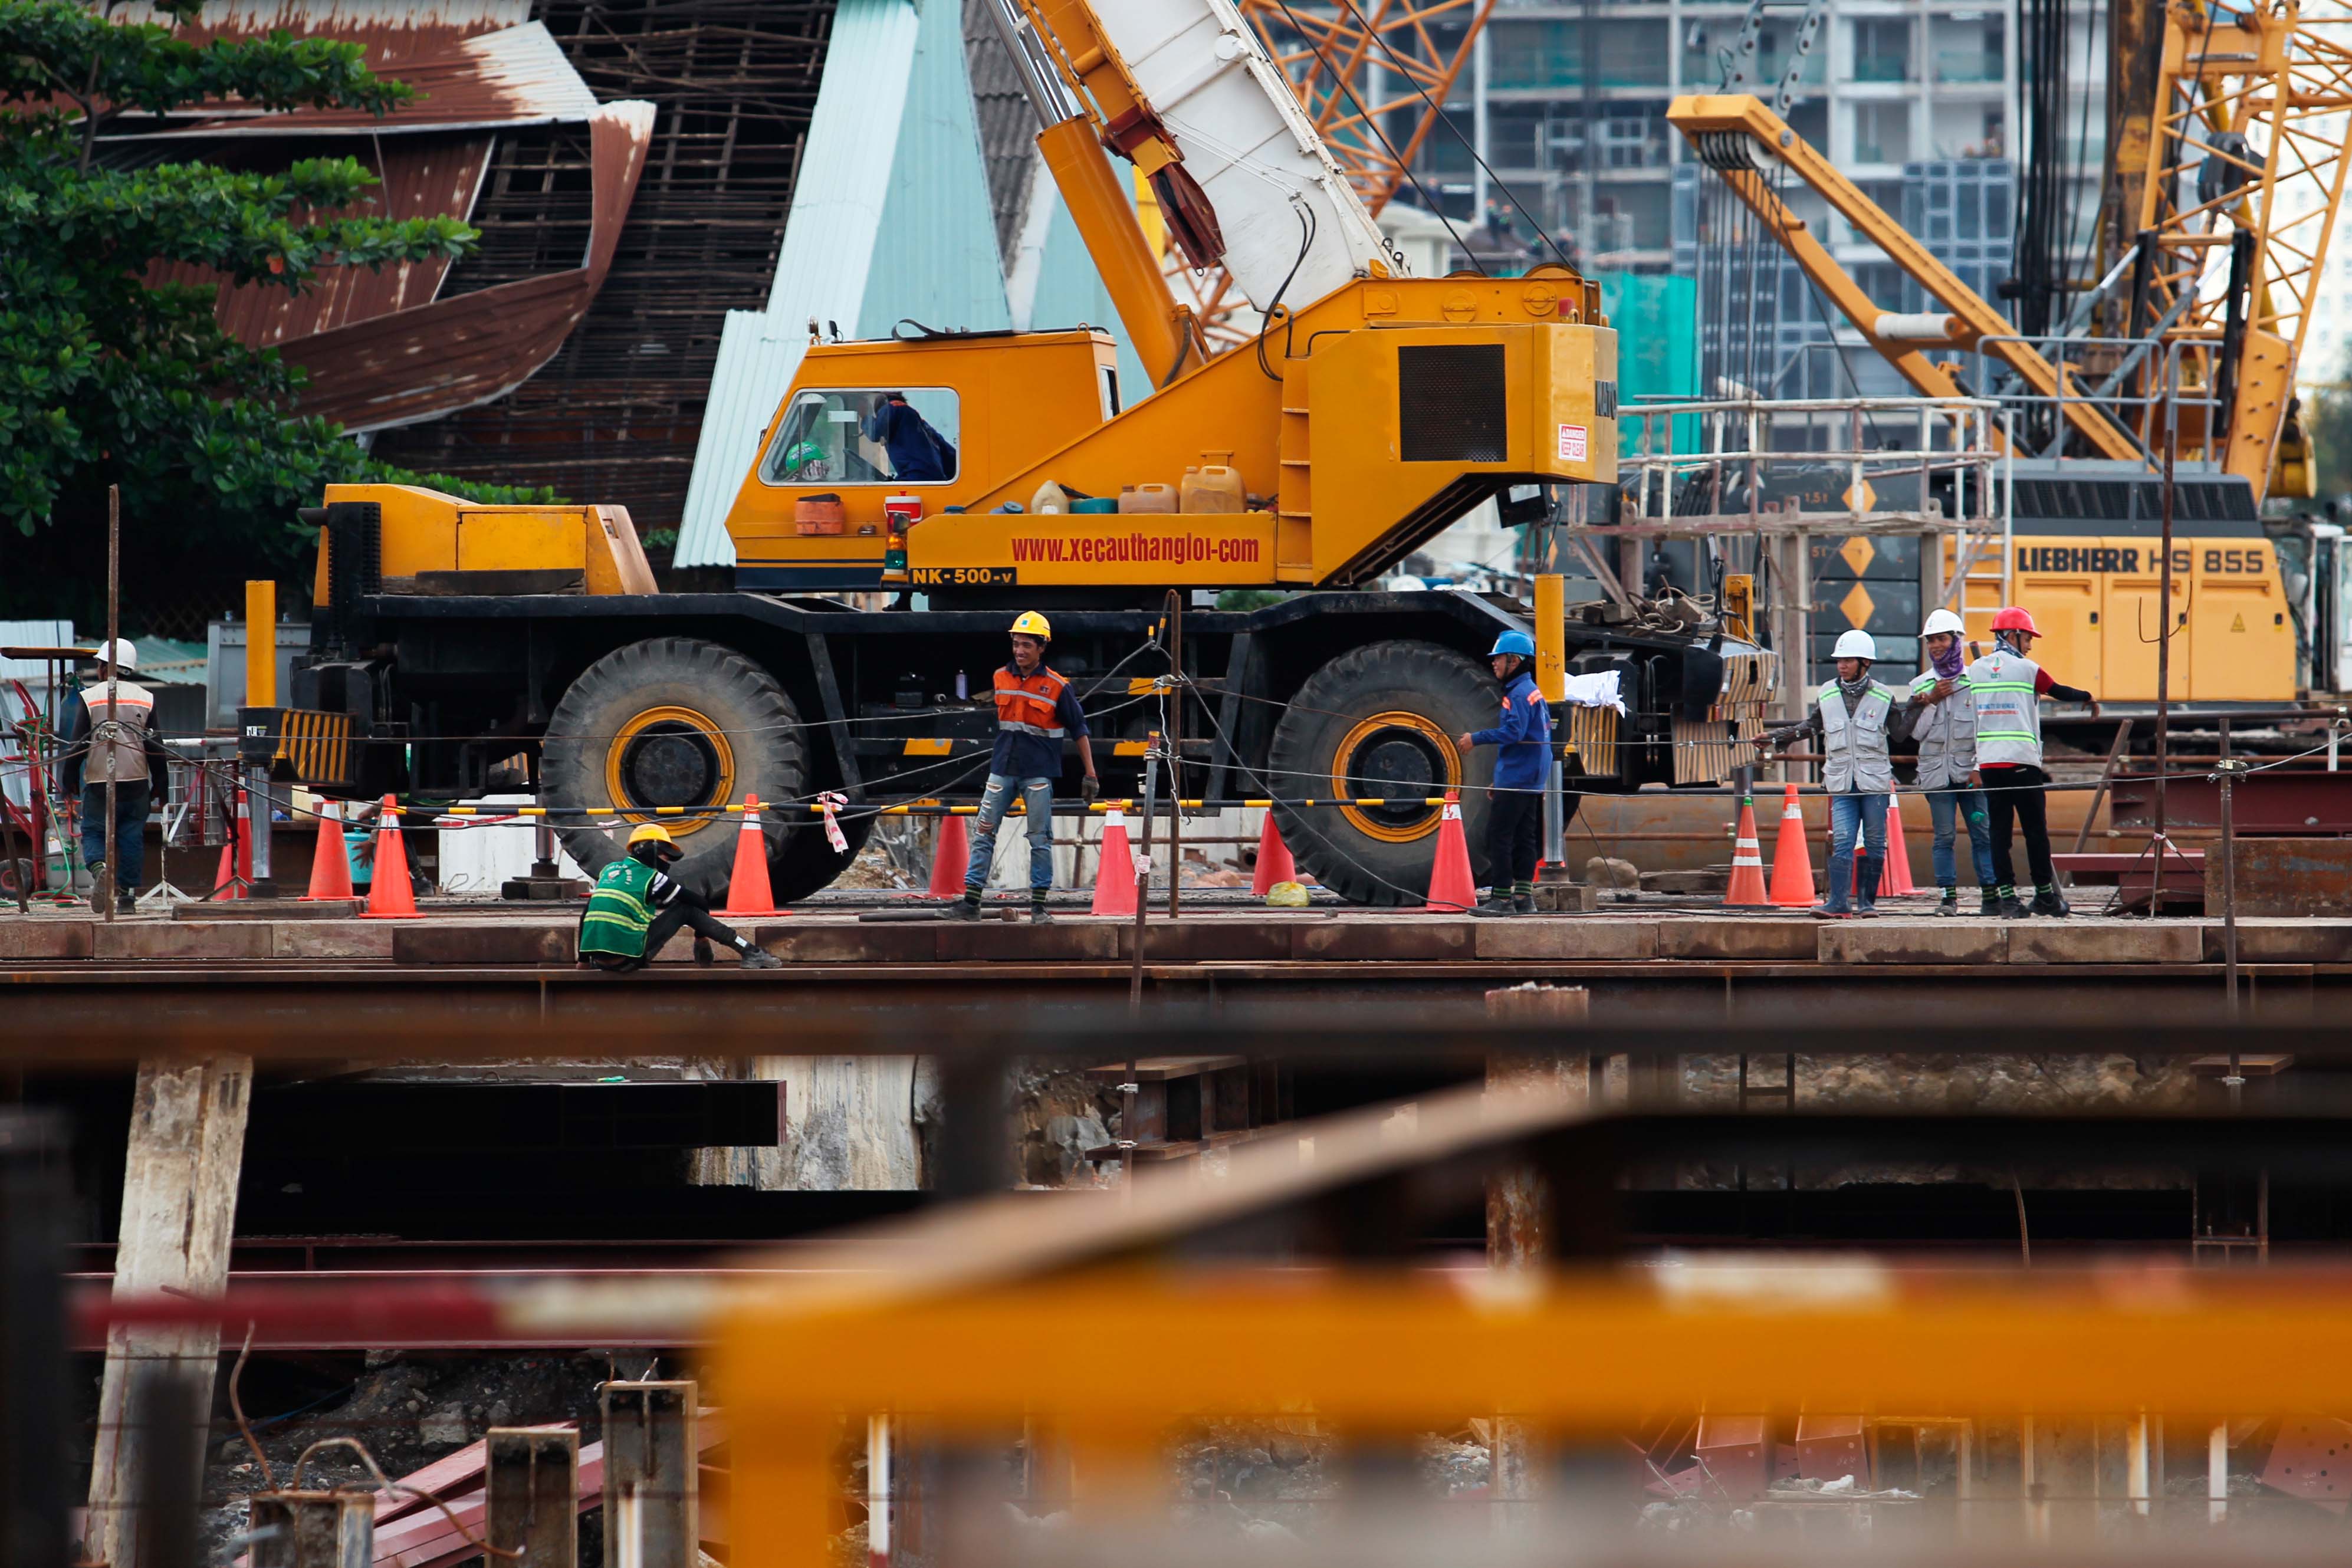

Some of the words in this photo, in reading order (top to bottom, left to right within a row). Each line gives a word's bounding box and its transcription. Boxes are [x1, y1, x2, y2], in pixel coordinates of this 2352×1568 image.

[2018, 547, 2139, 573] LIEBHERR
[2149, 549, 2190, 574] HS
[2204, 549, 2264, 574] 855
